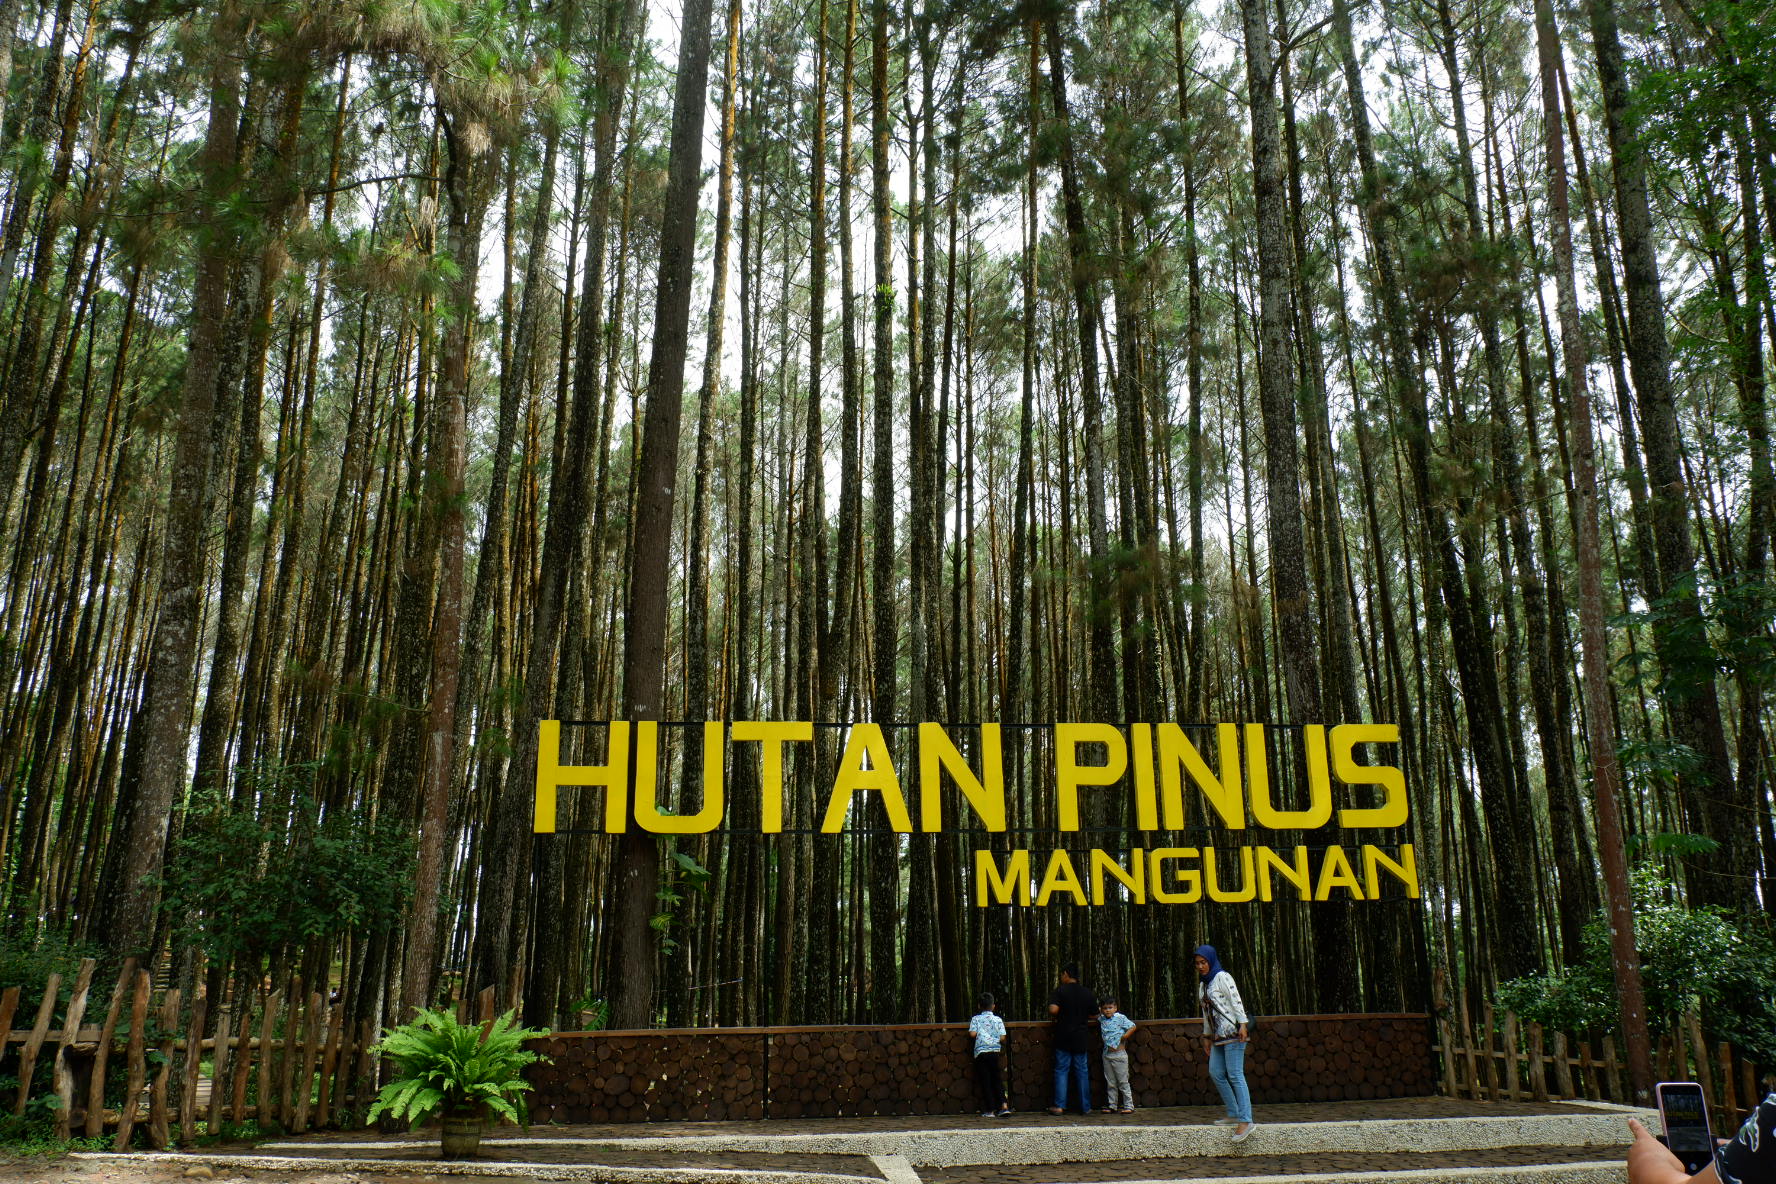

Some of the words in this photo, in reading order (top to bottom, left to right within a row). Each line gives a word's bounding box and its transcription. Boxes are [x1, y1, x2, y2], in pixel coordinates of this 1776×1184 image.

[533, 719, 1006, 834] HUTAN
[1055, 722, 1409, 832] PINUS
[976, 843, 1420, 907] MANGUNAN
